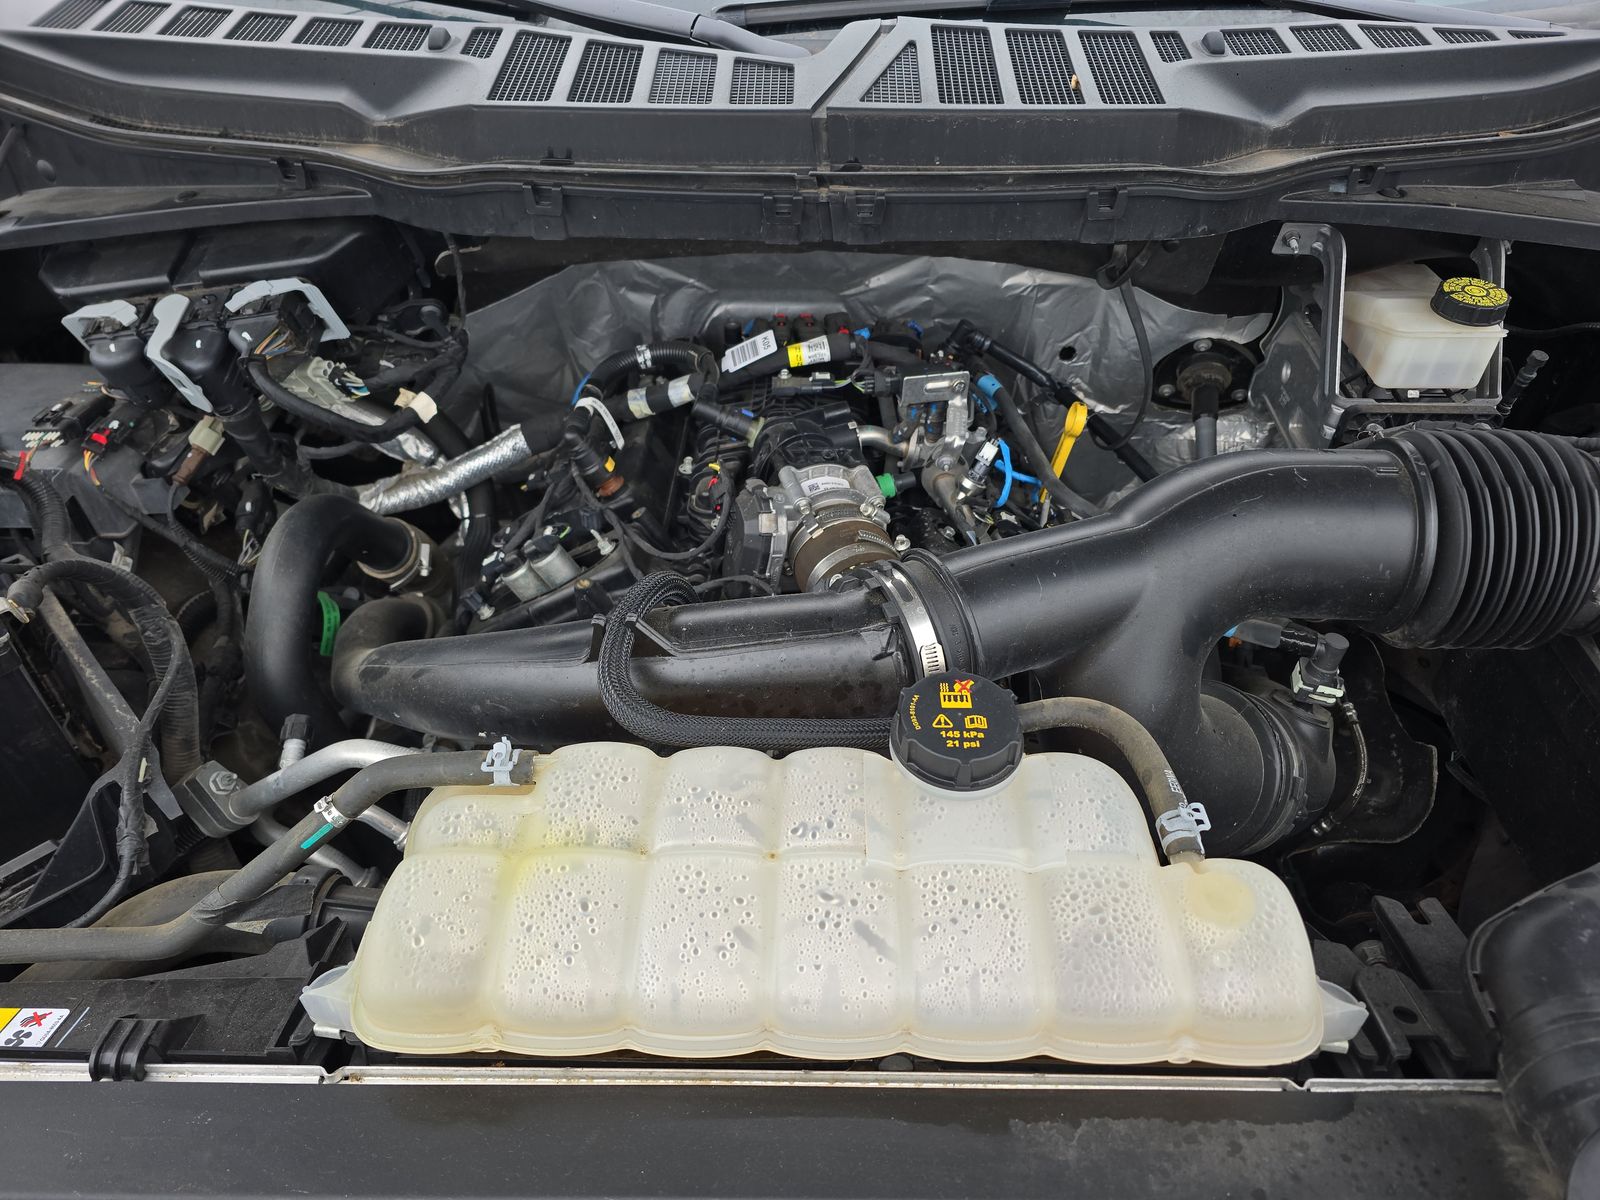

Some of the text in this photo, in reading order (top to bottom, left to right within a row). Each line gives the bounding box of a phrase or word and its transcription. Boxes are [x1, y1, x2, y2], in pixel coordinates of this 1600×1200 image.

[761, 335, 771, 351] K05
[940, 730, 985, 738] 145 kPa
[963, 740, 980, 749] psi
